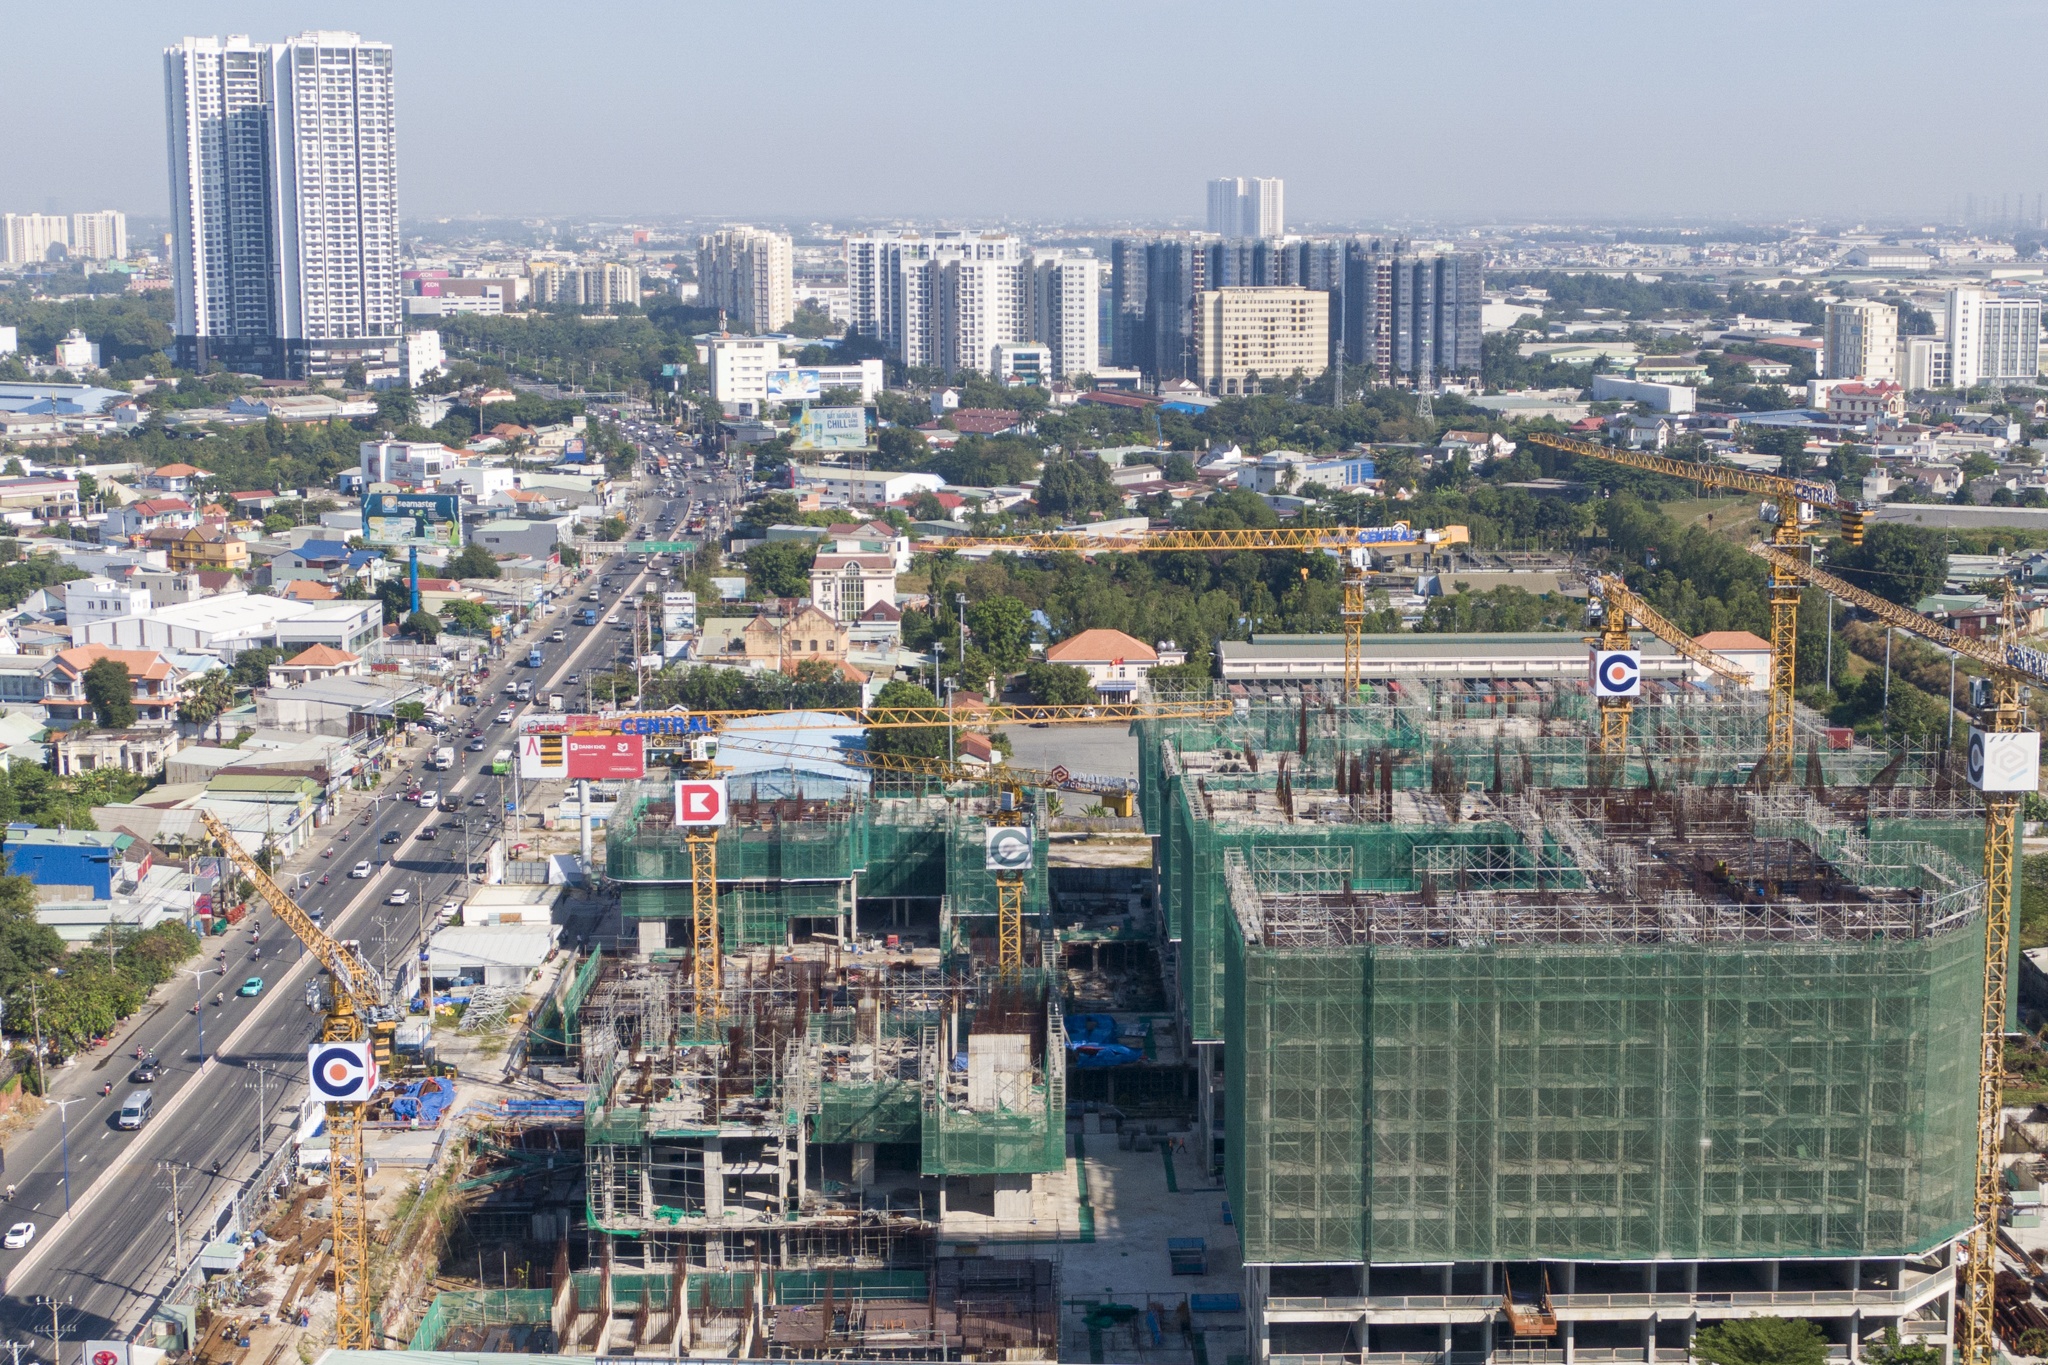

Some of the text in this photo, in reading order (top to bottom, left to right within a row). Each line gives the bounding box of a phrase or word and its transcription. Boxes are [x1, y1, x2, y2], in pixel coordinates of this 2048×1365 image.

[827, 419, 848, 429] CHILL
[1795, 483, 1836, 505] CENTRAL
[397, 500, 437, 508] seamaster
[621, 716, 712, 735] CENTRAL
